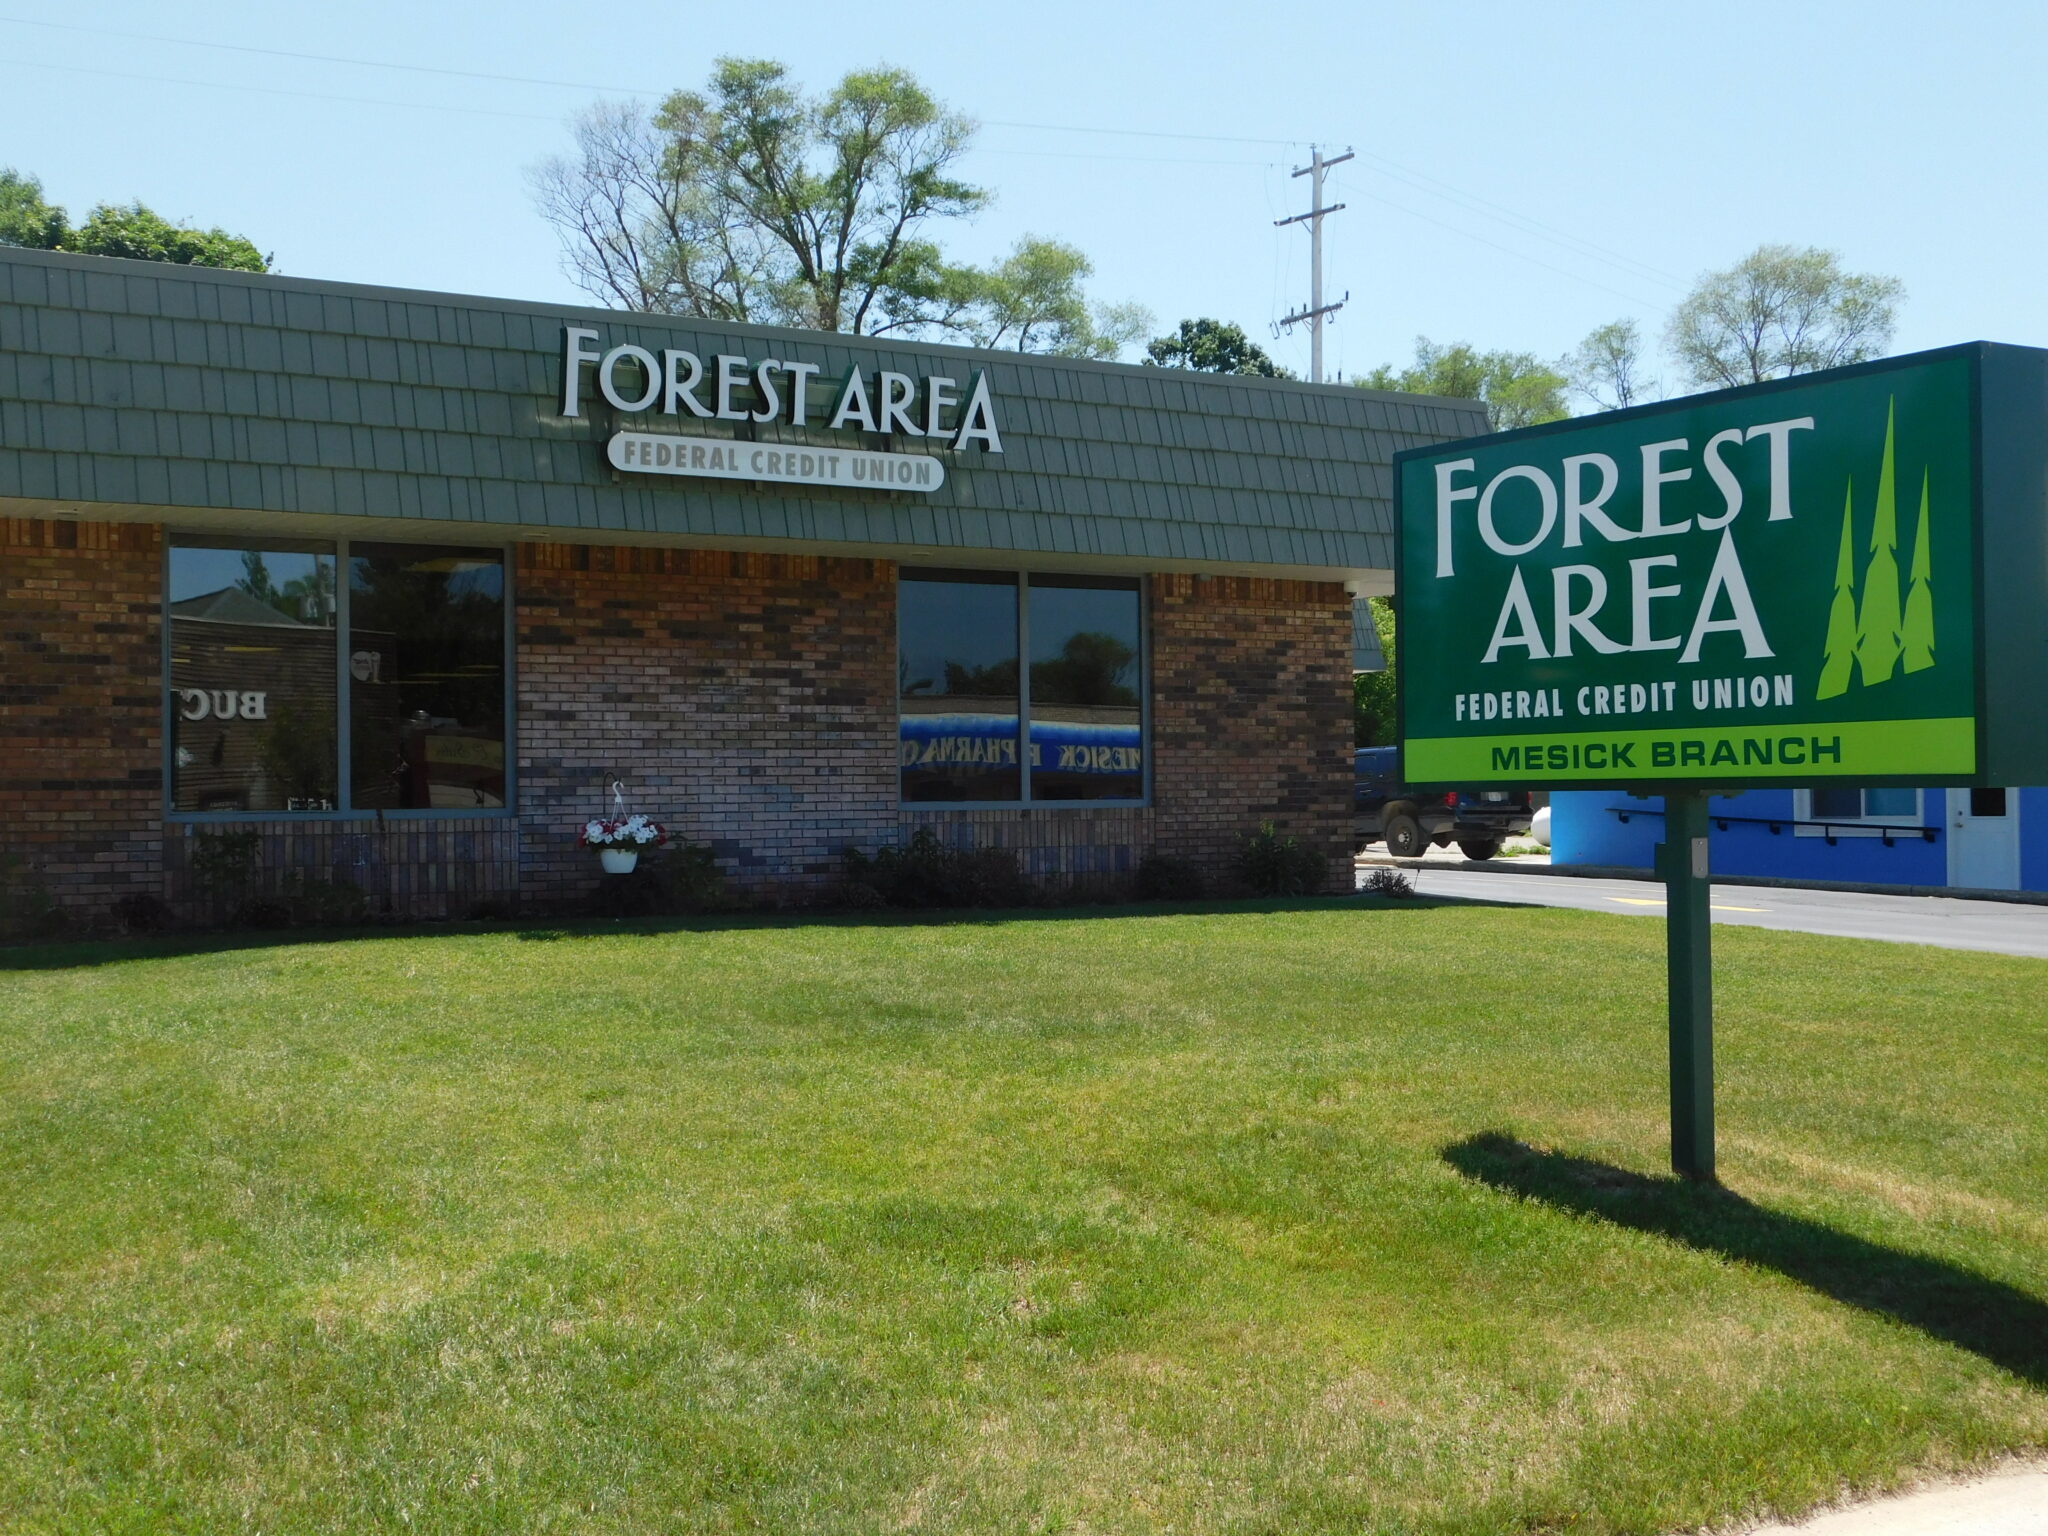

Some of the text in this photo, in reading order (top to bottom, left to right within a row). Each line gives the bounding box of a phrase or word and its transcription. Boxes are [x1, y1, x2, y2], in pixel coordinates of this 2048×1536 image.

[562, 327, 1004, 453] FOREST AREA
[624, 440, 931, 486] FEDERAL CREDIT UNION
[1434, 416, 1815, 578] FOREST
[1480, 524, 1776, 663] AREA
[1455, 674, 1794, 722] FEDERAL CREDIT UNION
[1491, 736, 1842, 771] MESICK BRANCH
